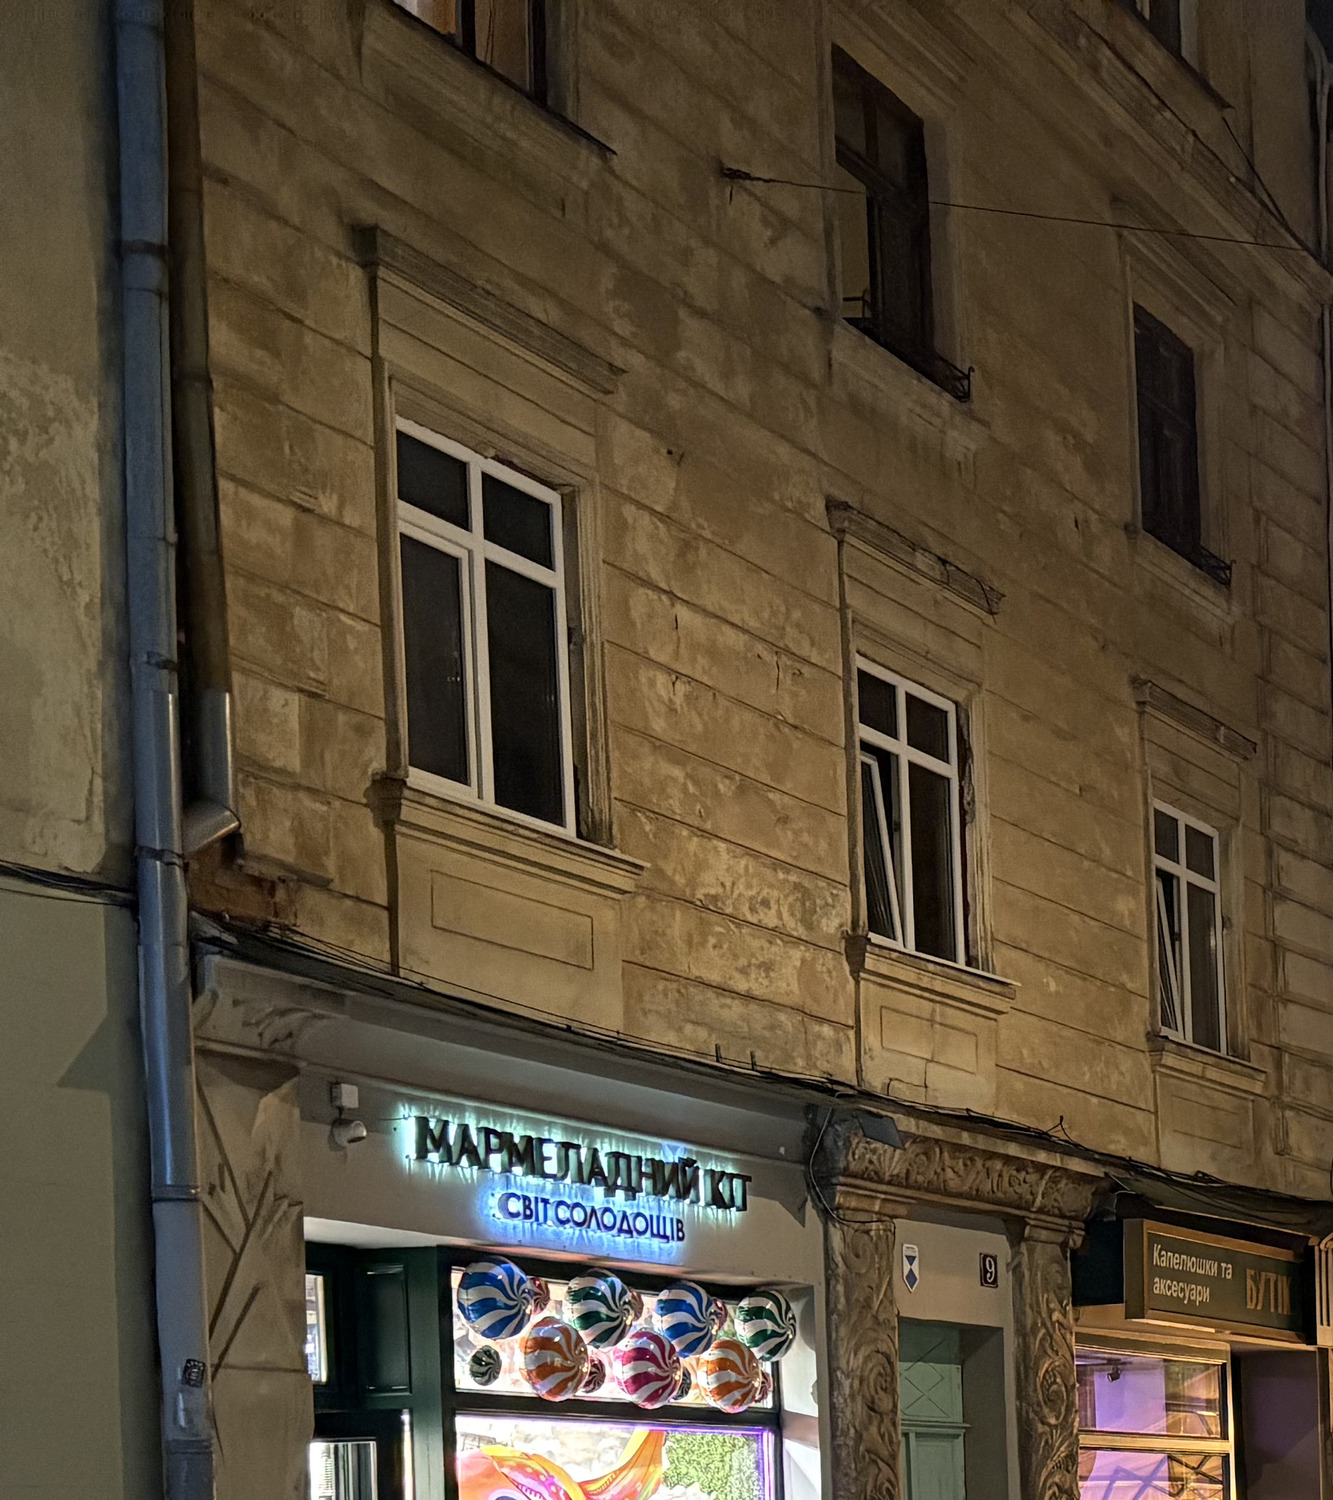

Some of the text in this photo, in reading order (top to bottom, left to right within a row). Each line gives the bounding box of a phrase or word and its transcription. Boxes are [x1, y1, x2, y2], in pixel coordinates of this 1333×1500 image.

[414, 1116, 753, 1212] МАРМЕЛАДНИЙ КІТ
[498, 1191, 687, 1243] СВІТ СОЛОДОЩІВ
[986, 1257, 995, 1282] 9
[1152, 1243, 1233, 1280] Капелюшки та
[1152, 1277, 1211, 1306] аксесуари
